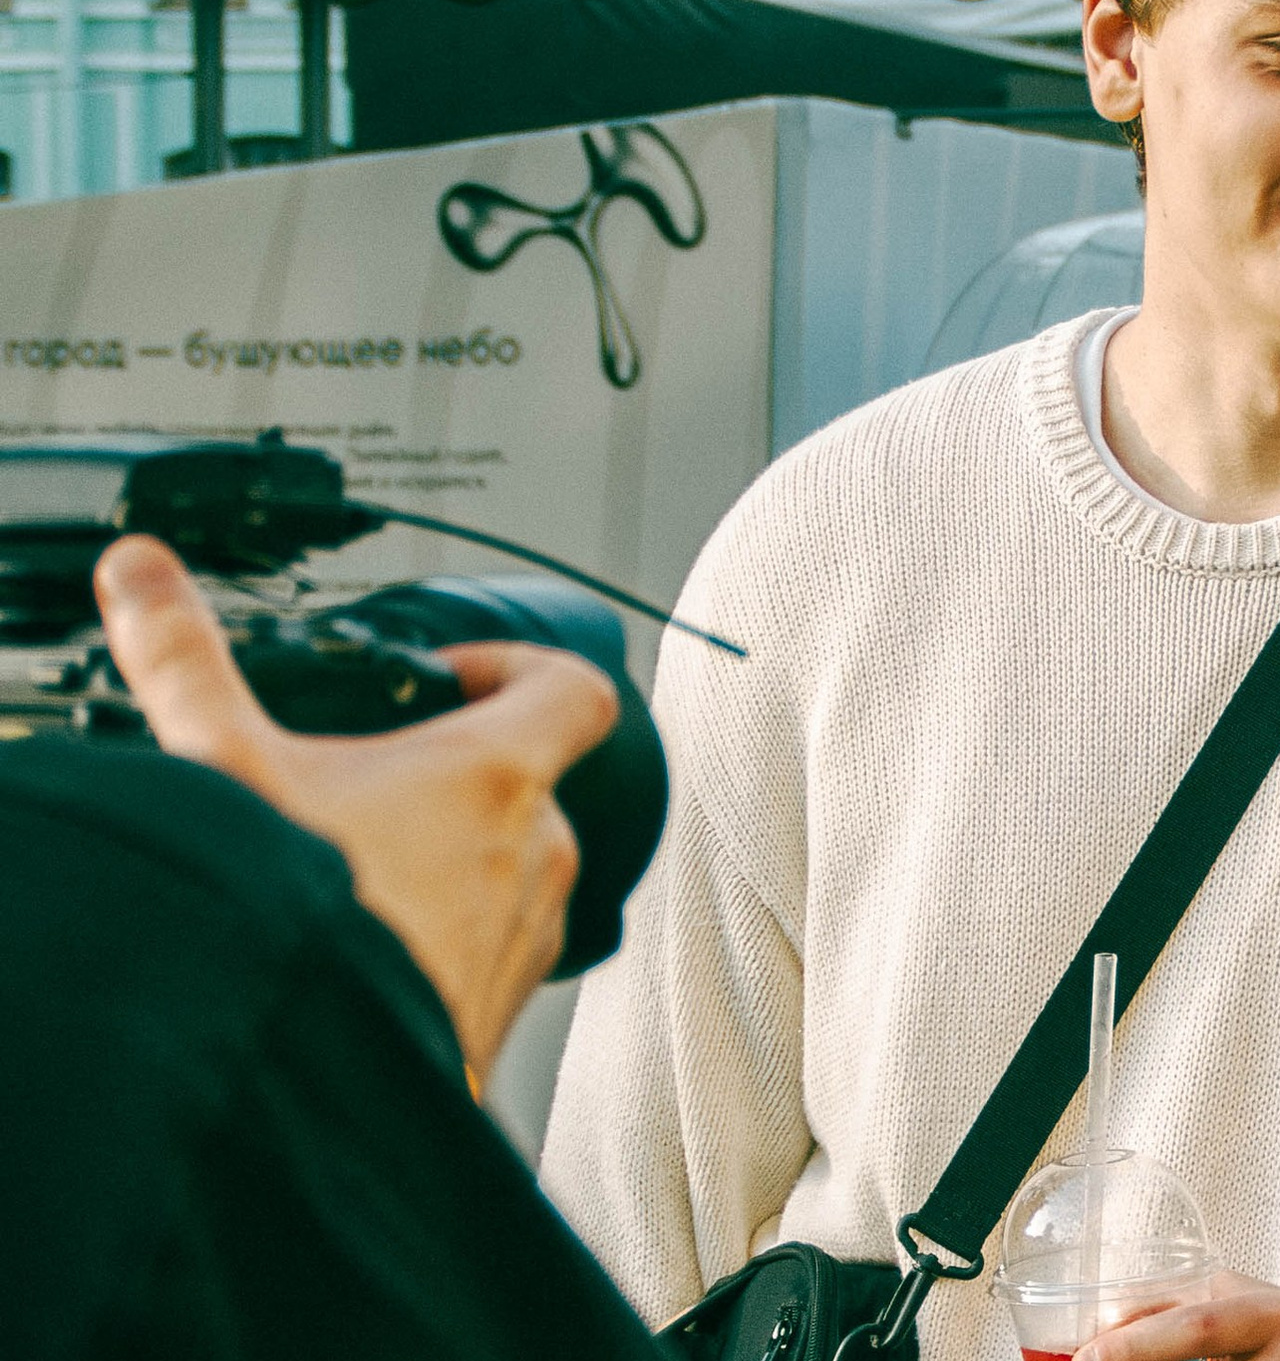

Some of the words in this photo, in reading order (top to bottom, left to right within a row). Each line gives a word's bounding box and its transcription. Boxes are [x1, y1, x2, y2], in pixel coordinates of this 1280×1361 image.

[4, 338, 127, 374] город
[184, 329, 403, 376] бушующее
[417, 327, 521, 367] небо
